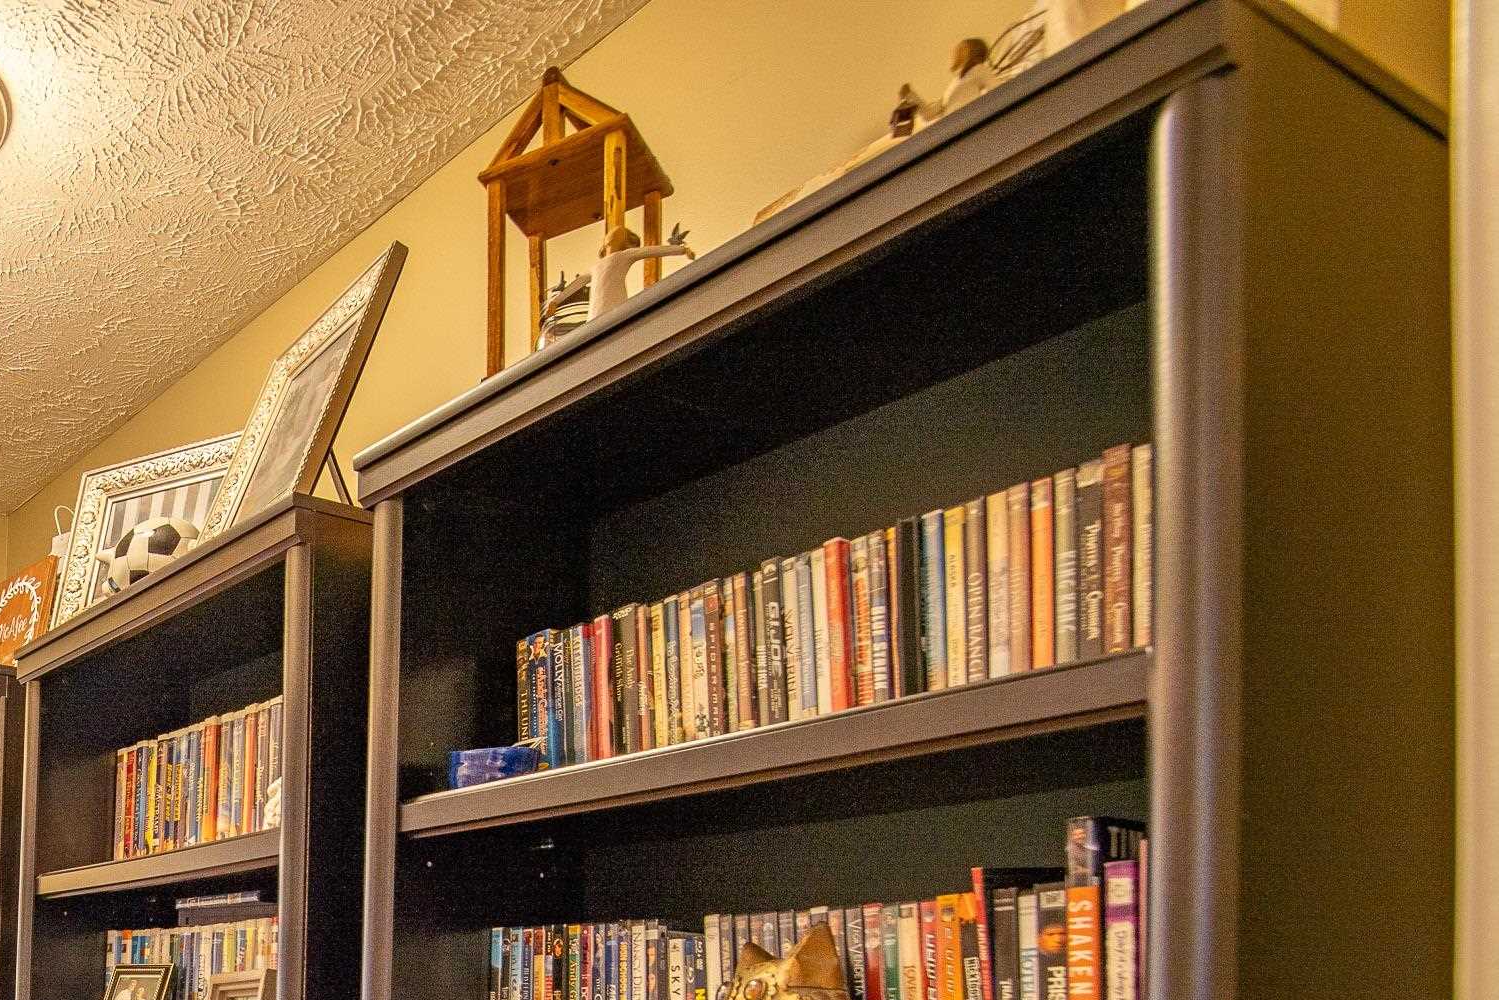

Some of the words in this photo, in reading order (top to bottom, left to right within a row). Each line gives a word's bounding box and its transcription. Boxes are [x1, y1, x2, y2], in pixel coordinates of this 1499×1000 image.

[967, 573, 981, 618] OPEN
[553, 643, 563, 682] MOLLY
[614, 643, 622, 678] Griffith
[626, 668, 635, 688] Andy
[633, 932, 643, 972] NANCY
[1068, 899, 1093, 996] SHAKEN
[569, 960, 578, 987] Andy
